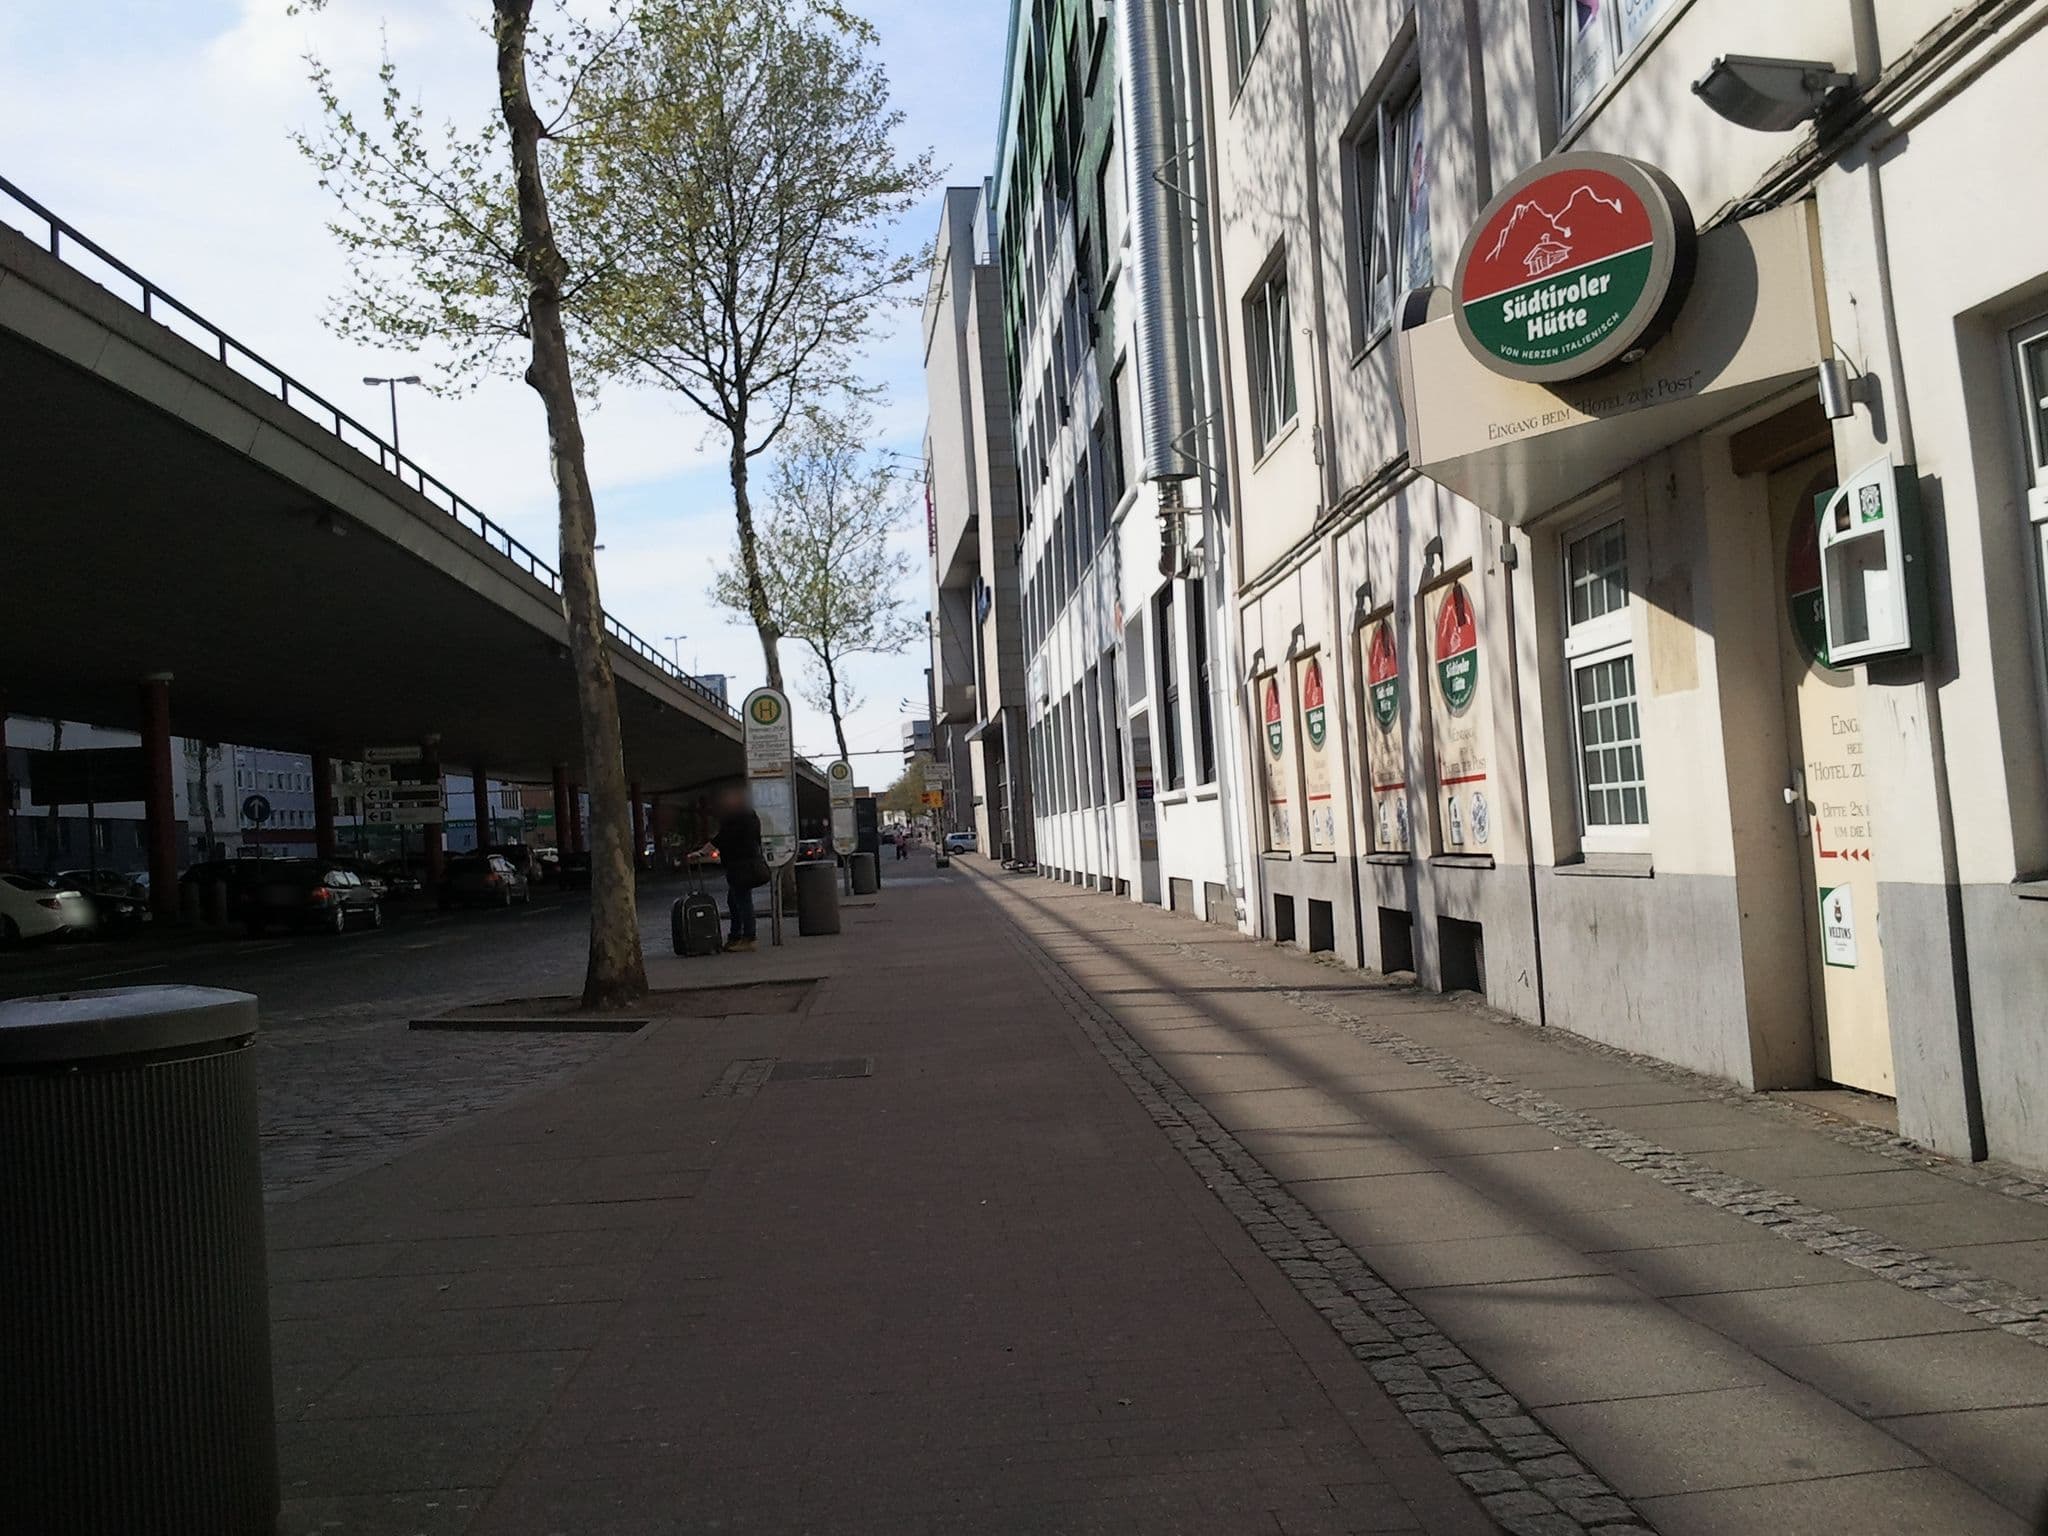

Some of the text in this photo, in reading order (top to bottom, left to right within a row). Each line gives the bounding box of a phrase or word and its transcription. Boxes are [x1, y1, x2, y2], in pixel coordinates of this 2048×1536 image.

[1502, 273, 1611, 324] Südtiroler
[1500, 311, 1620, 360] VON HERZEN ITALIENISCH
[1526, 308, 1588, 342] Hütte
[759, 701, 773, 719] H
[1831, 715, 1860, 735] EING
[1828, 926, 1852, 940] VELTINS
